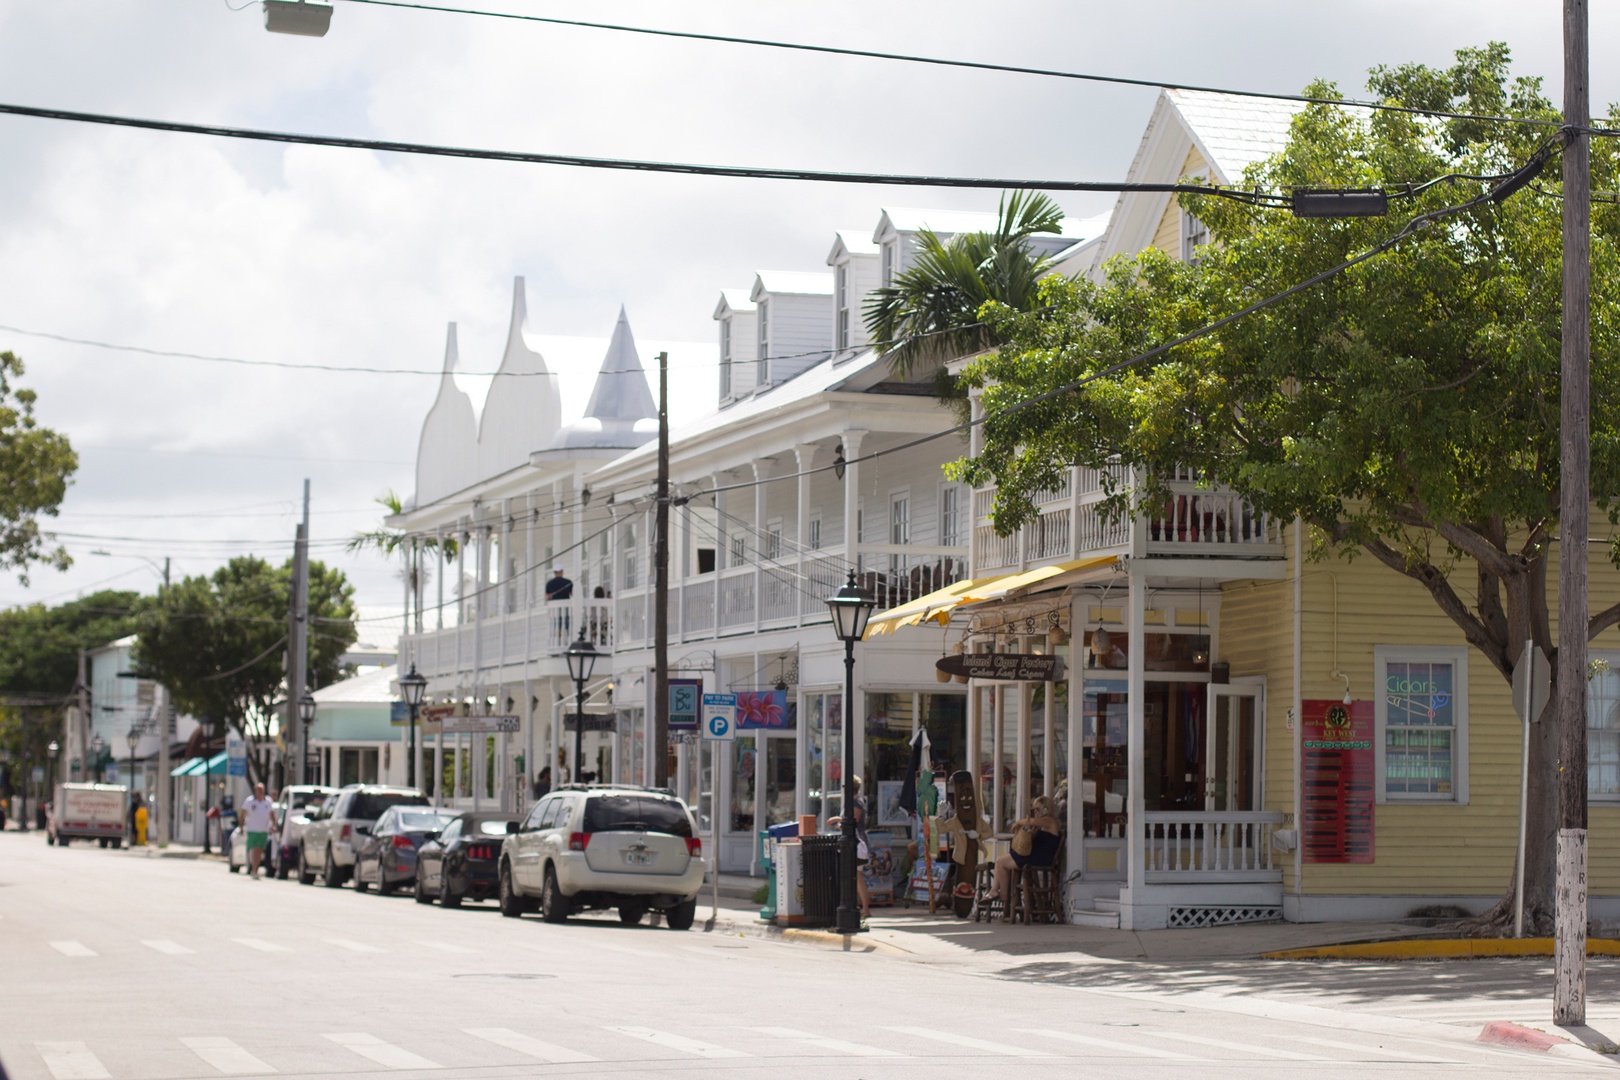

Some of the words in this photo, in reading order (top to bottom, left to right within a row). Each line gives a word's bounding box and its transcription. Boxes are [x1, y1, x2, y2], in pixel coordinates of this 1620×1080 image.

[963, 655, 992, 666] Island
[994, 656, 1019, 669] Cigar
[1021, 656, 1054, 670] Factory
[1387, 676, 1437, 693] Cigars
[676, 688, 690, 700] So
[676, 700, 690, 710] Du
[714, 719, 725, 733] P
[1323, 729, 1337, 737] KEY
[1338, 729, 1357, 737] WEST
[1577, 833, 1586, 981] VIRGINIA
